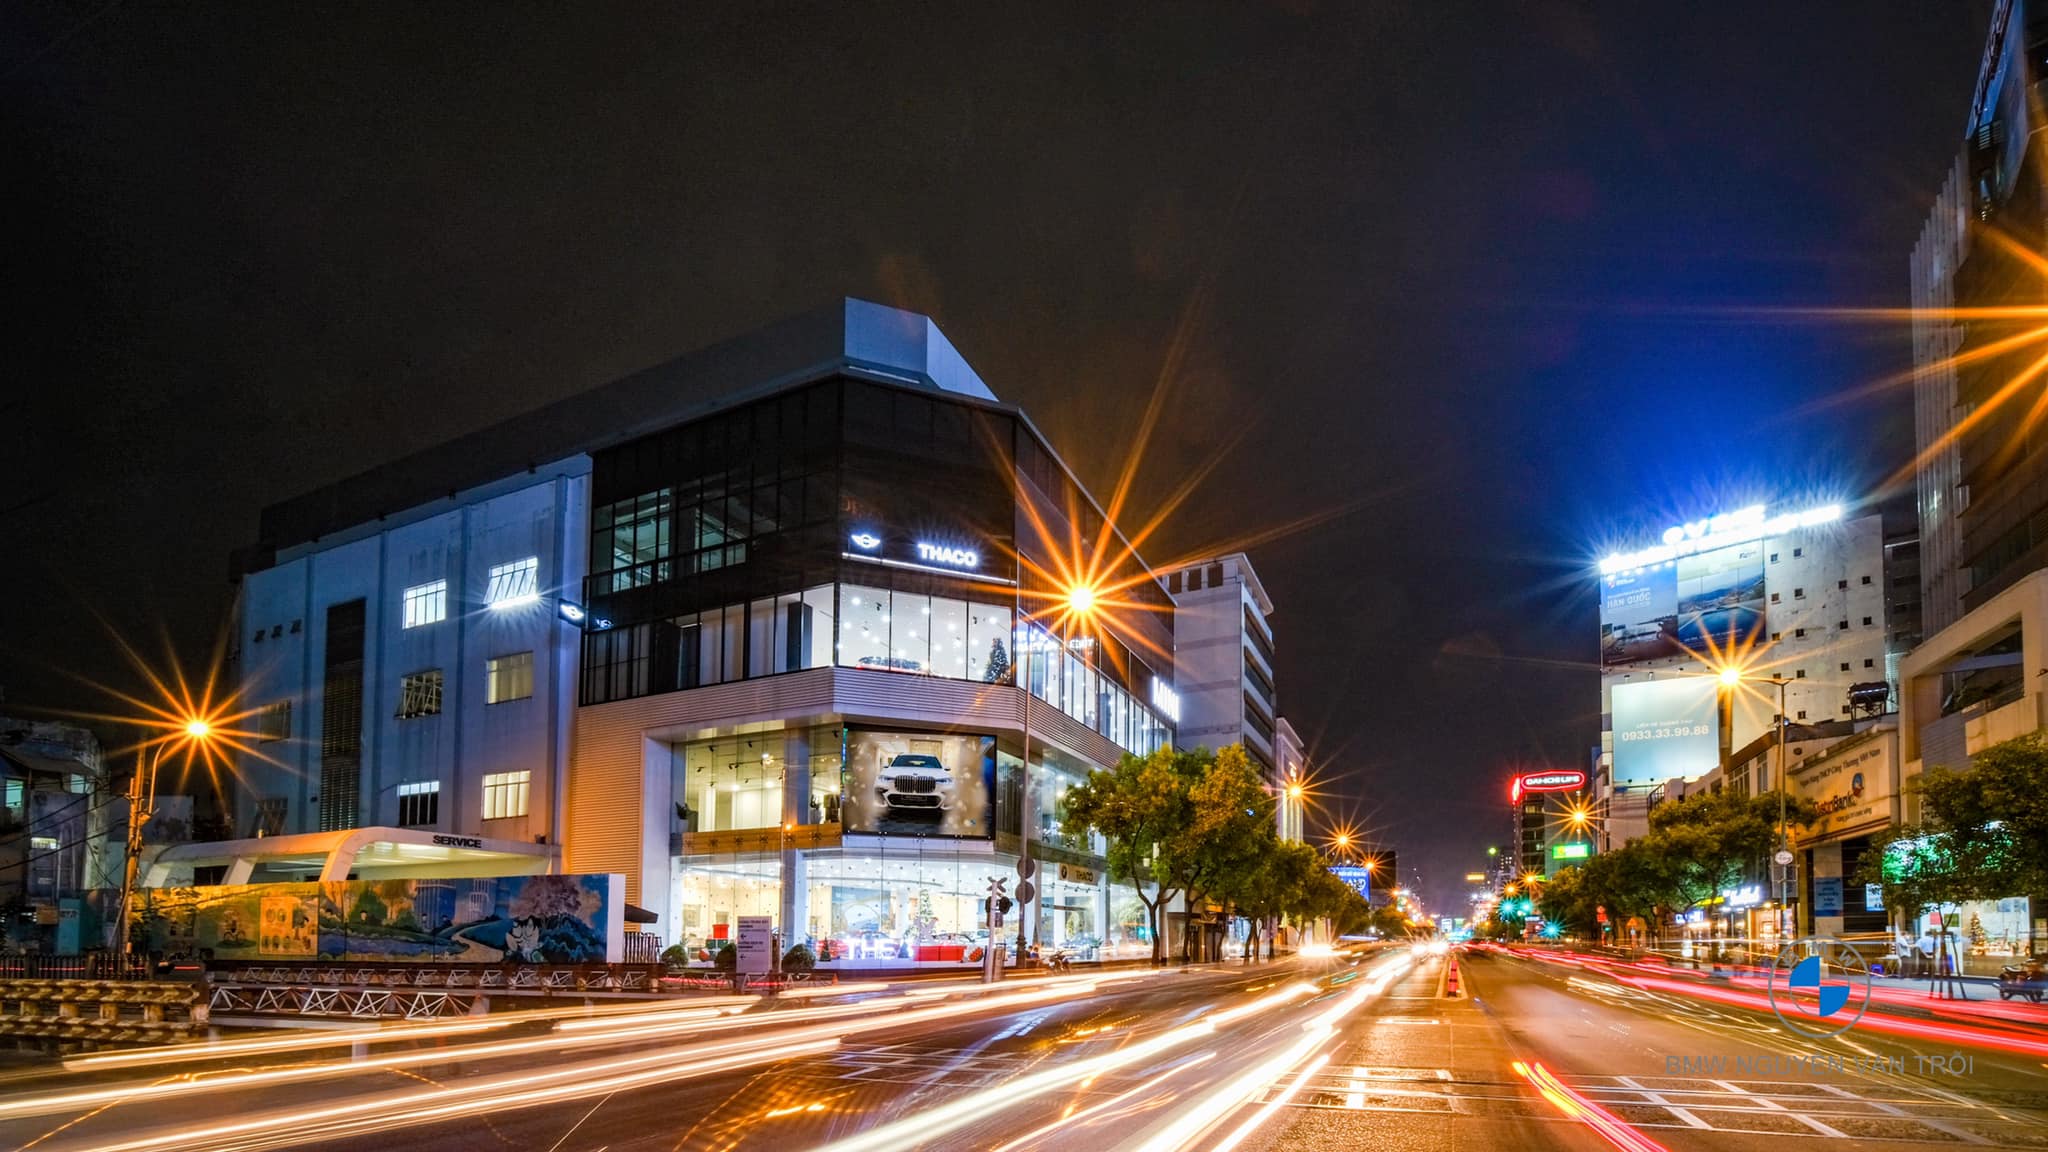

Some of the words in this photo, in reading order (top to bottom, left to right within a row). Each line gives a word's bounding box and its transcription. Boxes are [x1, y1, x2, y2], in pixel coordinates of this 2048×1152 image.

[918, 543, 977, 567] THACO
[1152, 676, 1179, 722] MINI
[432, 835, 482, 849] SERVICE
